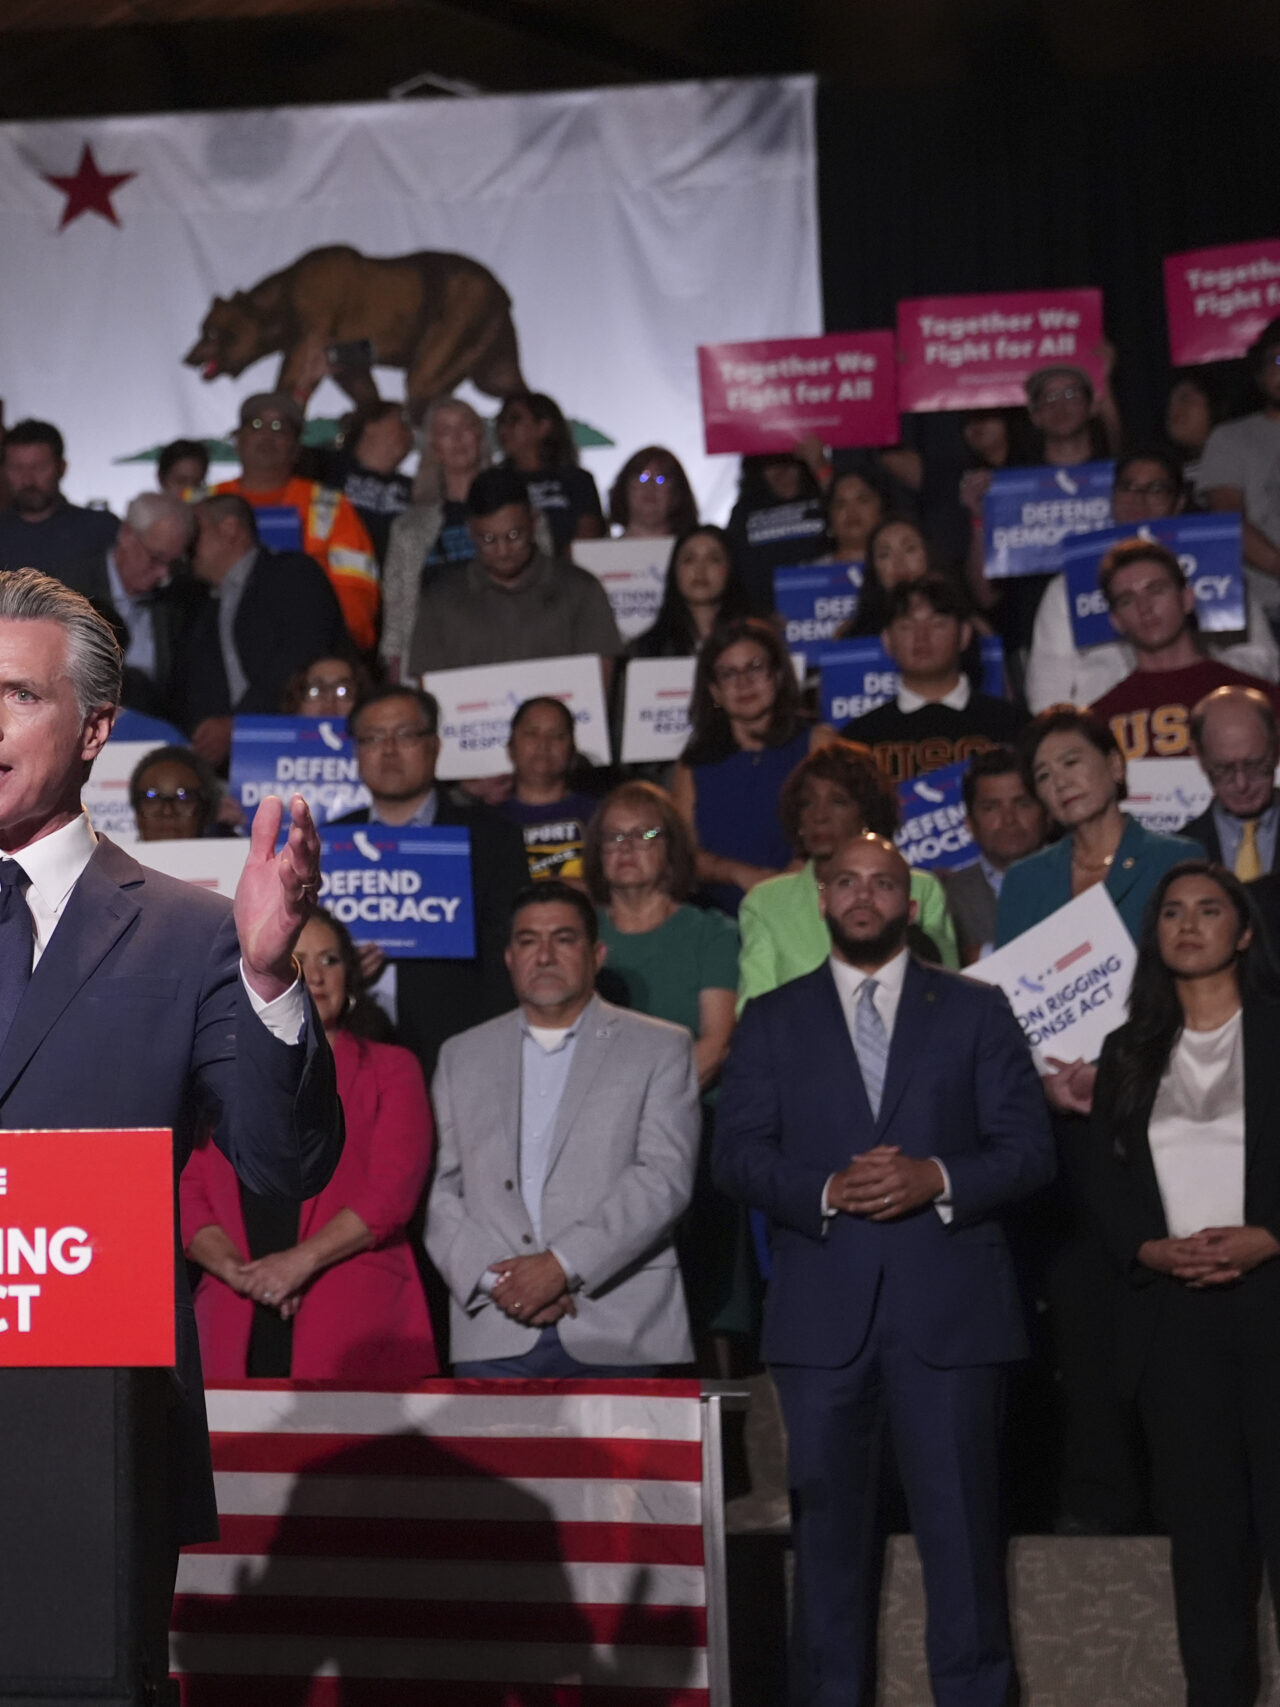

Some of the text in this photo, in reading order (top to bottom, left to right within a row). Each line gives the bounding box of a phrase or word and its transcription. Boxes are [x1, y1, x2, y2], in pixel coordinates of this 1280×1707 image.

[1184, 257, 1280, 291] Togeth
[918, 307, 1080, 341] Together We
[721, 349, 877, 386] Together We
[924, 332, 1077, 368] Fight for All
[726, 375, 874, 413] Fight for All
[814, 595, 858, 620] DEF
[1108, 703, 1190, 760] US
[277, 757, 358, 782] DEFEN
[240, 781, 375, 809] DEMOCRA
[523, 821, 577, 845] PORT
[893, 801, 967, 847] DEFEN
[333, 896, 462, 922] OCRACY
[1045, 955, 1121, 1013] RIGGING
[1027, 1009, 1076, 1047] ONSE
[1080, 982, 1112, 1018] ACT
